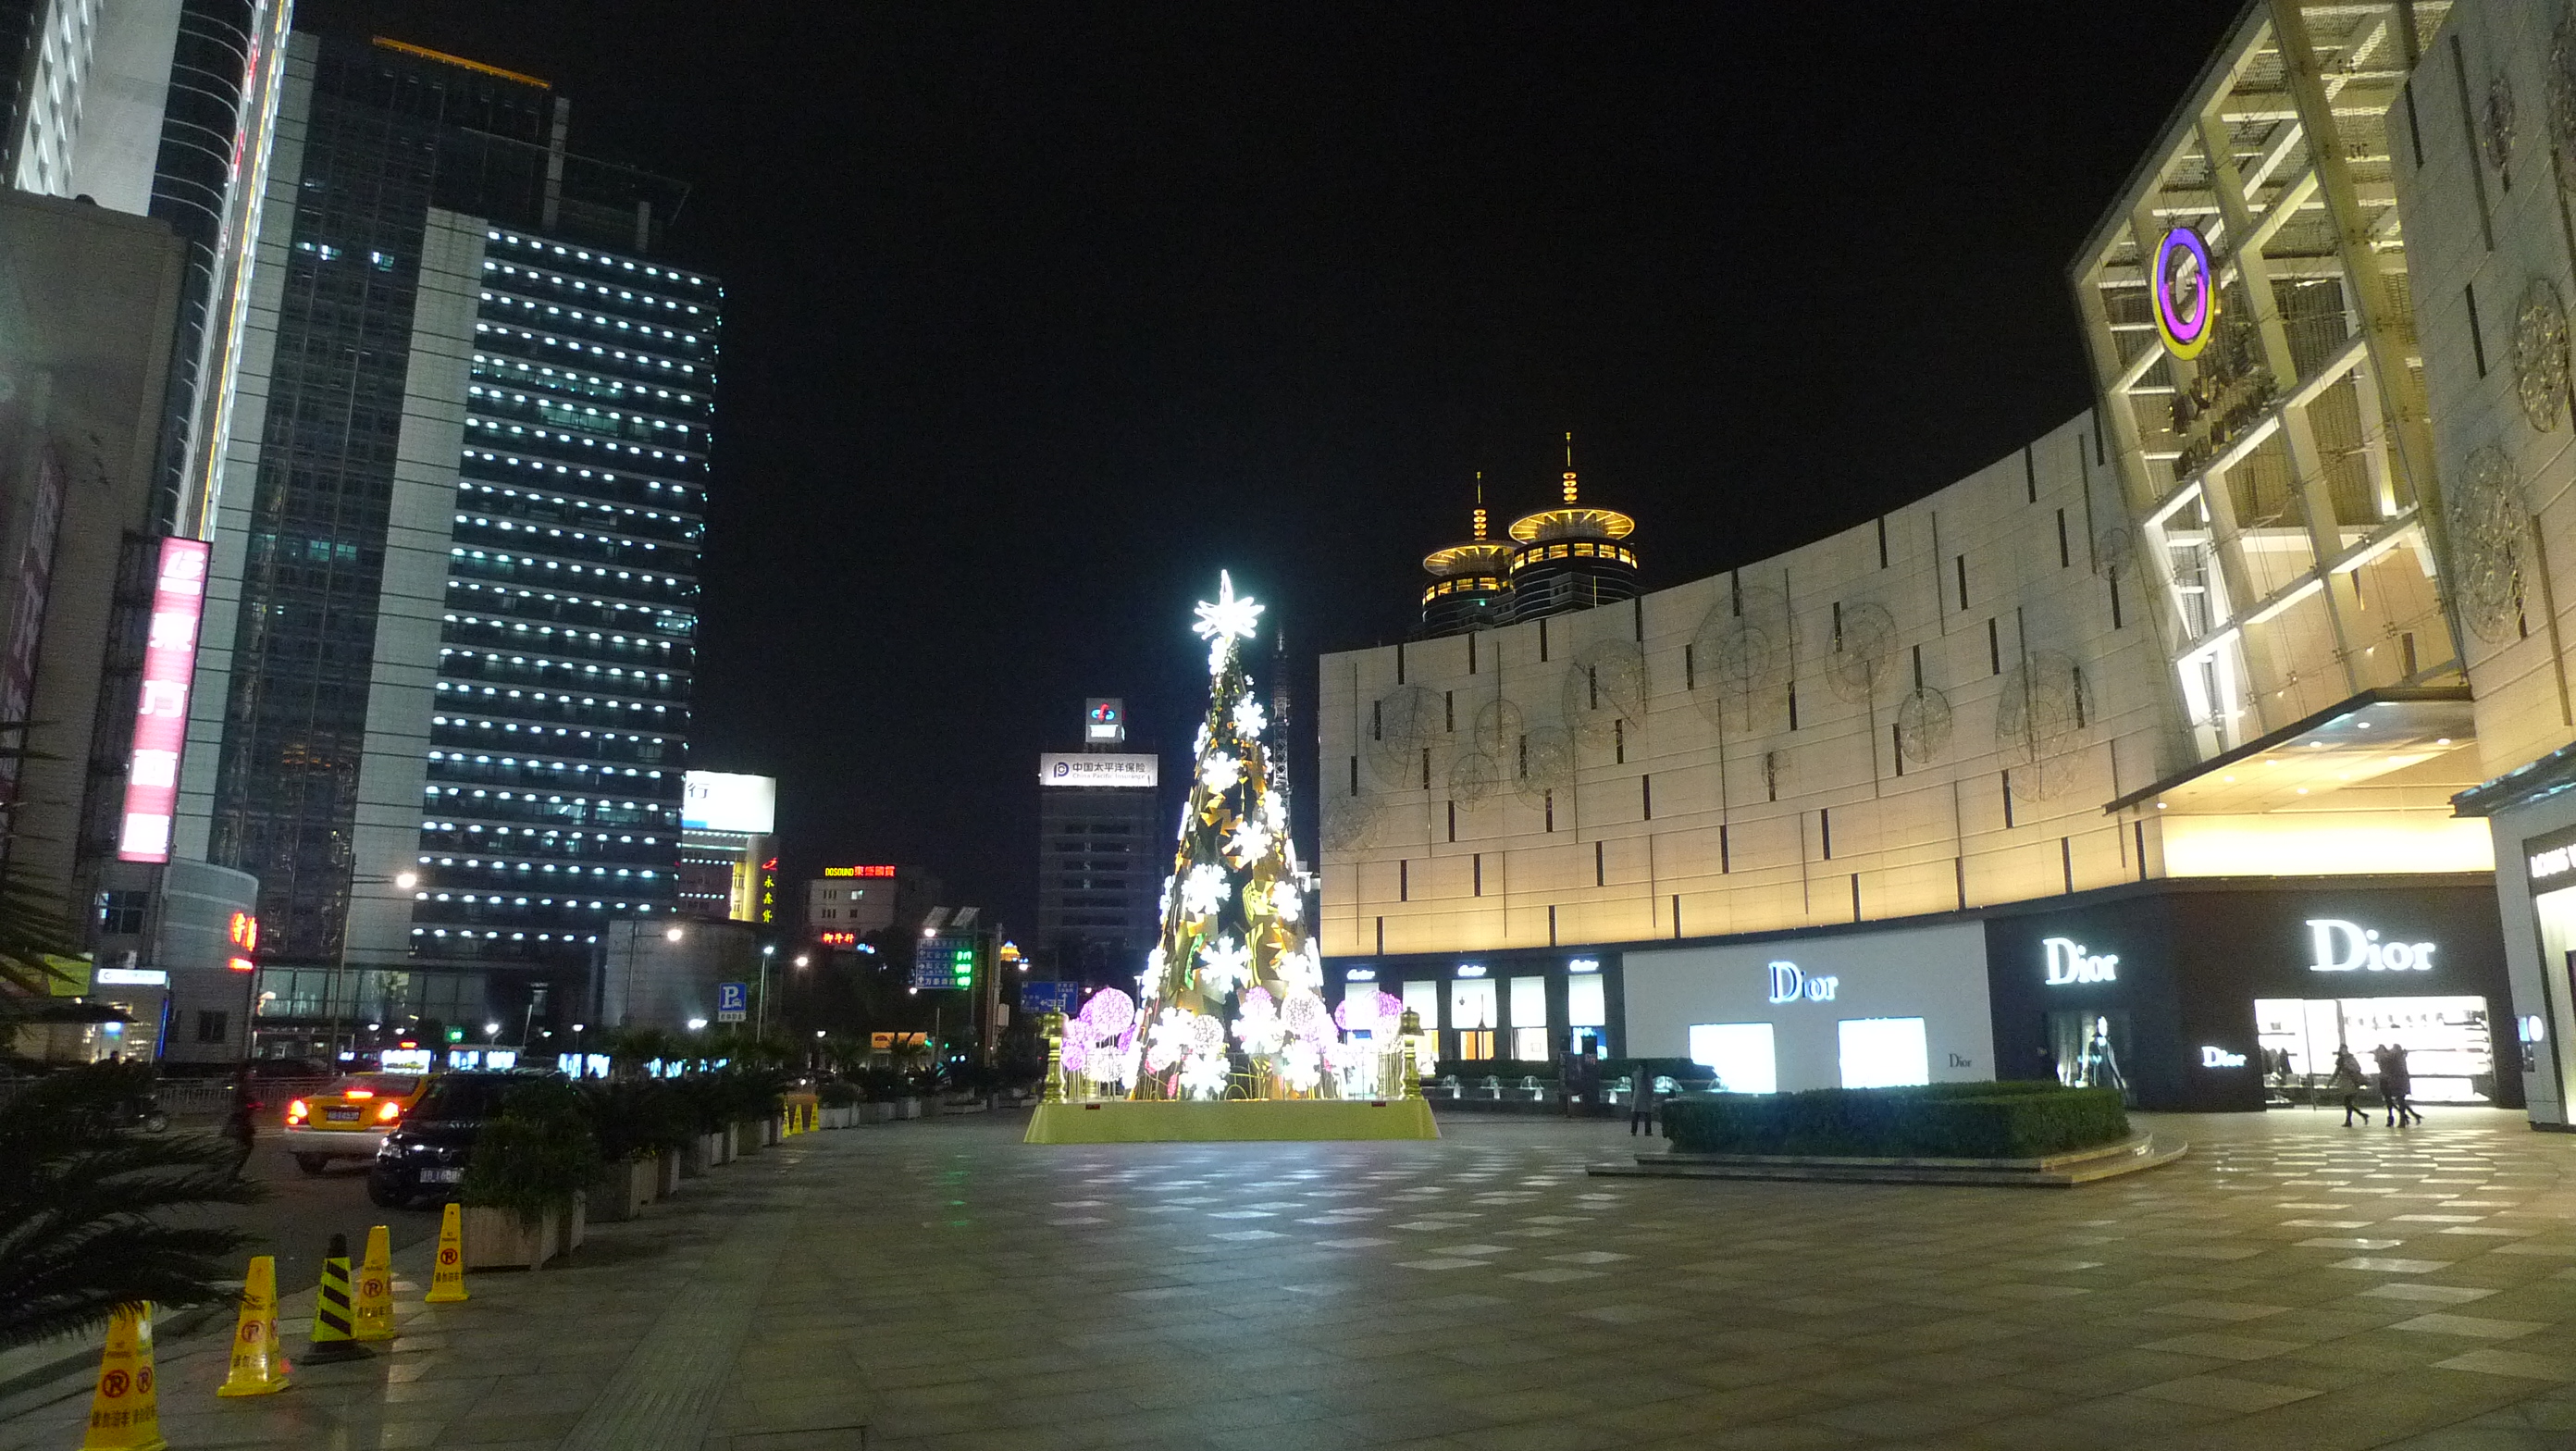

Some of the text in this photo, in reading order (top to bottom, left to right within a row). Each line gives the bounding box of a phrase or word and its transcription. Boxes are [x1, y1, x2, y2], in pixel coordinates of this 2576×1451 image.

[1072, 763, 1146, 773] 中国太平洋保险
[687, 782, 711, 800] 行
[2306, 919, 2435, 972] Dior
[1569, 959, 1600, 972] Cartier
[2042, 937, 2119, 985] Dior
[1346, 968, 1376, 981] Cartier
[1457, 964, 1487, 977] Cartier
[1768, 960, 1839, 1003] Dior
[1949, 1053, 1972, 1068] Dior
[2201, 1046, 2248, 1067] Dior
